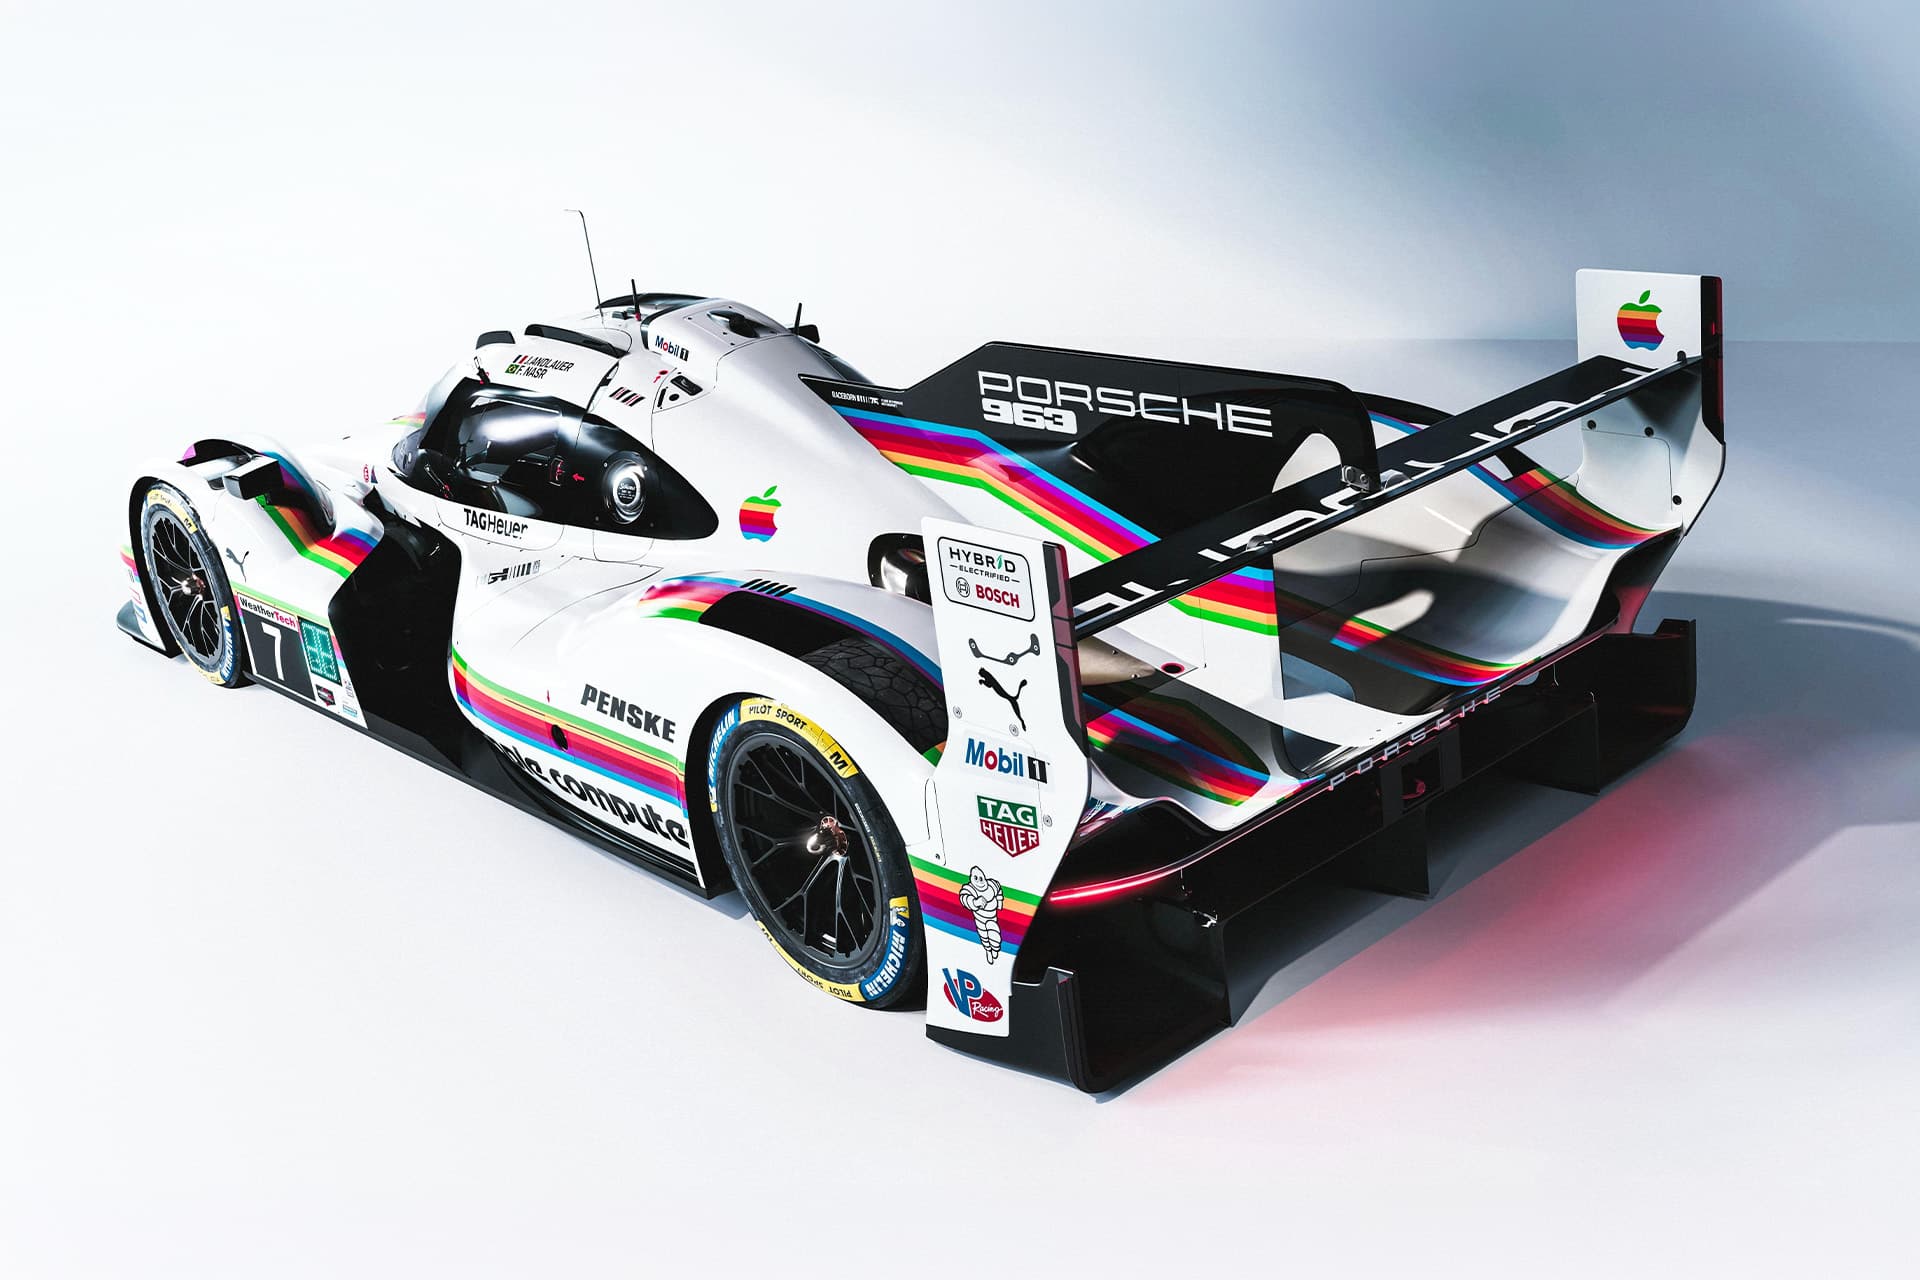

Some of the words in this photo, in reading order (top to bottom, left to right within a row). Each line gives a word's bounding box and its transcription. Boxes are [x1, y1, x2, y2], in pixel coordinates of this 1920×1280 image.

[655, 335, 680, 357] Mobil
[978, 371, 1273, 437] PORSCHE
[982, 398, 1078, 434] 963
[949, 547, 1016, 573] HYBRID
[959, 565, 1010, 582] ELECTRIFIED
[240, 596, 296, 628] WeatherTech
[976, 584, 1020, 608] BOSCH
[261, 622, 285, 681] 7
[581, 684, 676, 743] PENSKE
[749, 704, 773, 715] PILOT
[776, 708, 807, 730] SPORT
[708, 708, 736, 784] MICHELIN
[1328, 686, 1501, 791] PORSCHE
[830, 751, 849, 771] M
[965, 738, 1024, 777] Mobil
[499, 743, 551, 784] ple
[549, 768, 690, 850] compute
[980, 799, 1035, 826] TAG
[982, 821, 1039, 855] HEUER
[865, 929, 906, 998] MICHELIN
[828, 987, 853, 998] PILOT
[942, 967, 983, 1018] VP
[972, 1000, 1003, 1017] Racing
